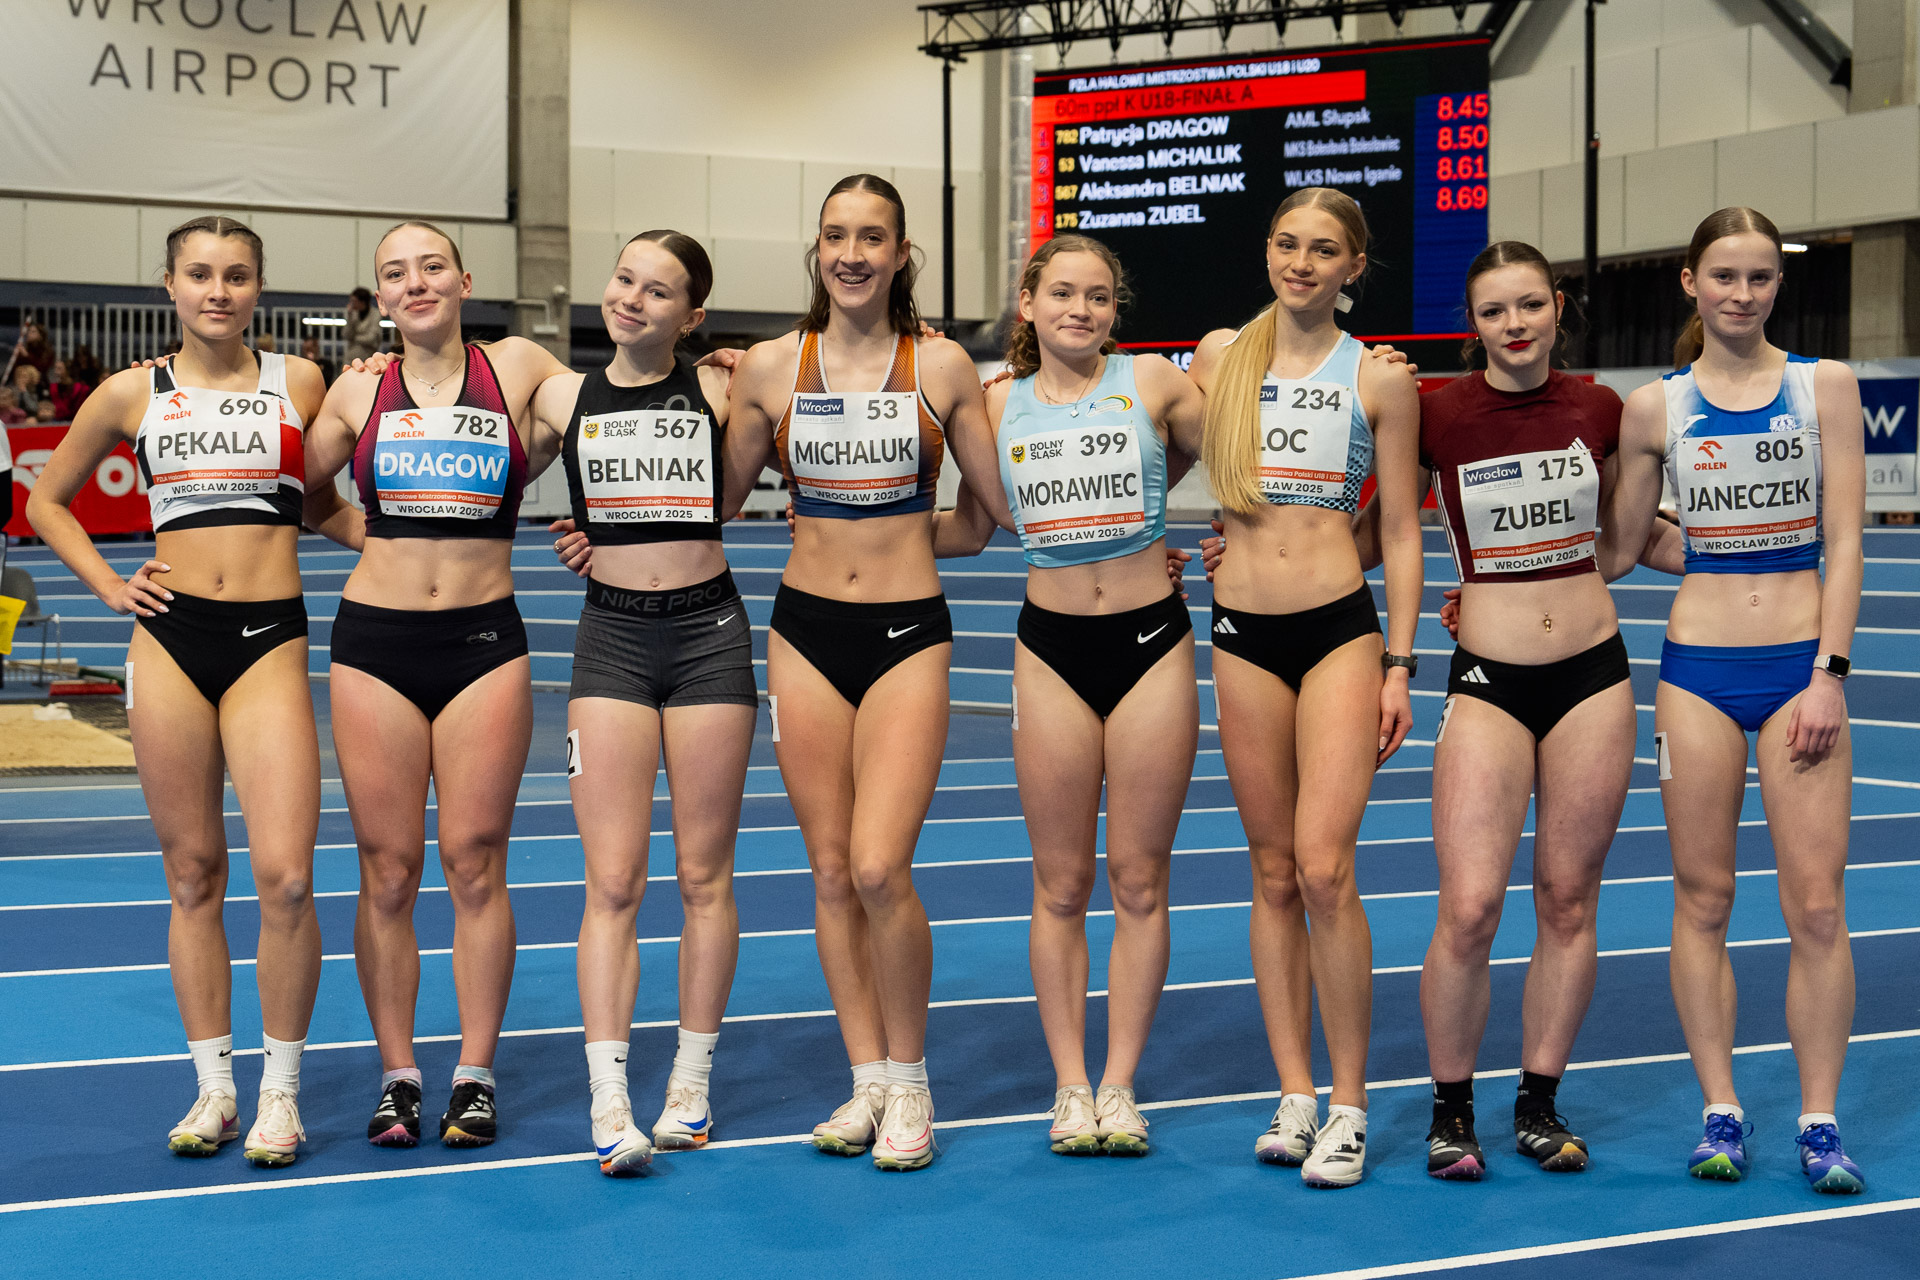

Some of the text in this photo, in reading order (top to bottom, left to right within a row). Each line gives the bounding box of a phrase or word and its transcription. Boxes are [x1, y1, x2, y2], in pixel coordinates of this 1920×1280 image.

[90, 43, 400, 107] AIRPORT
[1098, 73, 1145, 91] HALOWE
[1146, 66, 1225, 85] MISTRZOSTWA
[1226, 62, 1267, 79] POLSKI
[1055, 98, 1089, 116] 60m
[1125, 95, 1136, 110] K
[1141, 88, 1235, 110] U18-FINAŁ
[1241, 84, 1253, 101] A
[1437, 94, 1489, 121] 8.45
[1284, 110, 1320, 129] AML
[1039, 116, 1230, 147] 1 782 Patrycja DRAGOW
[1437, 124, 1489, 151] 8.50
[1038, 144, 1242, 175] 2 53 Vanessa MICHALUK
[1437, 155, 1488, 181] 8.61
[1038, 172, 1246, 203] 3 567 Aleksandra BELNIAK
[1284, 169, 1324, 187] WLKS
[1325, 168, 1362, 185] Nowe
[1437, 185, 1488, 211] 8.69
[1038, 203, 1206, 229] 4 175 Zuzanna ZUBEL
[219, 398, 268, 416] 690
[867, 399, 898, 420] 53
[1291, 387, 1341, 411] 234
[163, 410, 192, 421] ORLEN
[453, 413, 498, 439] 782
[604, 419, 638, 430] DOLNY
[393, 430, 425, 439] ORLEN
[604, 428, 637, 438] ŚLĄSK
[654, 418, 700, 439] 567
[158, 431, 268, 461] PĘKALA
[795, 437, 914, 465] MICHALUK
[1030, 439, 1064, 451] DOLNY
[1030, 448, 1063, 460] ŚLĄSK
[1080, 432, 1128, 457] 399
[1755, 437, 1804, 463] 805
[188, 471, 227, 479] Mistrzostwa
[228, 470, 247, 478] Polski
[378, 452, 506, 482] DRAGOW
[587, 457, 705, 484] BELNIAK
[1466, 466, 1519, 483] Wrocław
[1537, 456, 1584, 482] 175
[1694, 462, 1727, 471] ORLEN
[172, 482, 259, 495] WROCŁAW 2025
[457, 494, 476, 502] Polski
[815, 490, 900, 502] WROCŁAW 2025
[1018, 472, 1137, 509] MORAWIEC
[1295, 483, 1324, 493] 2025
[1688, 477, 1811, 513] JANECZEK
[397, 505, 483, 517] WROCŁAW 2025
[604, 509, 693, 520] WROCŁAW 2025
[1490, 499, 1576, 532] ZUBEL
[1055, 519, 1094, 528] Mistrzostwa
[1727, 526, 1768, 535] Mistrzostwa
[1804, 518, 1814, 526] U20
[1038, 527, 1125, 545] WROCŁAW 2025
[1704, 534, 1800, 550] WROCŁAW 2025
[1516, 544, 1551, 555] Mistrzostwa
[1552, 540, 1569, 548] Polski
[1495, 548, 1579, 570] WROCŁAW 2025
[600, 583, 722, 612] NIKE PRO
